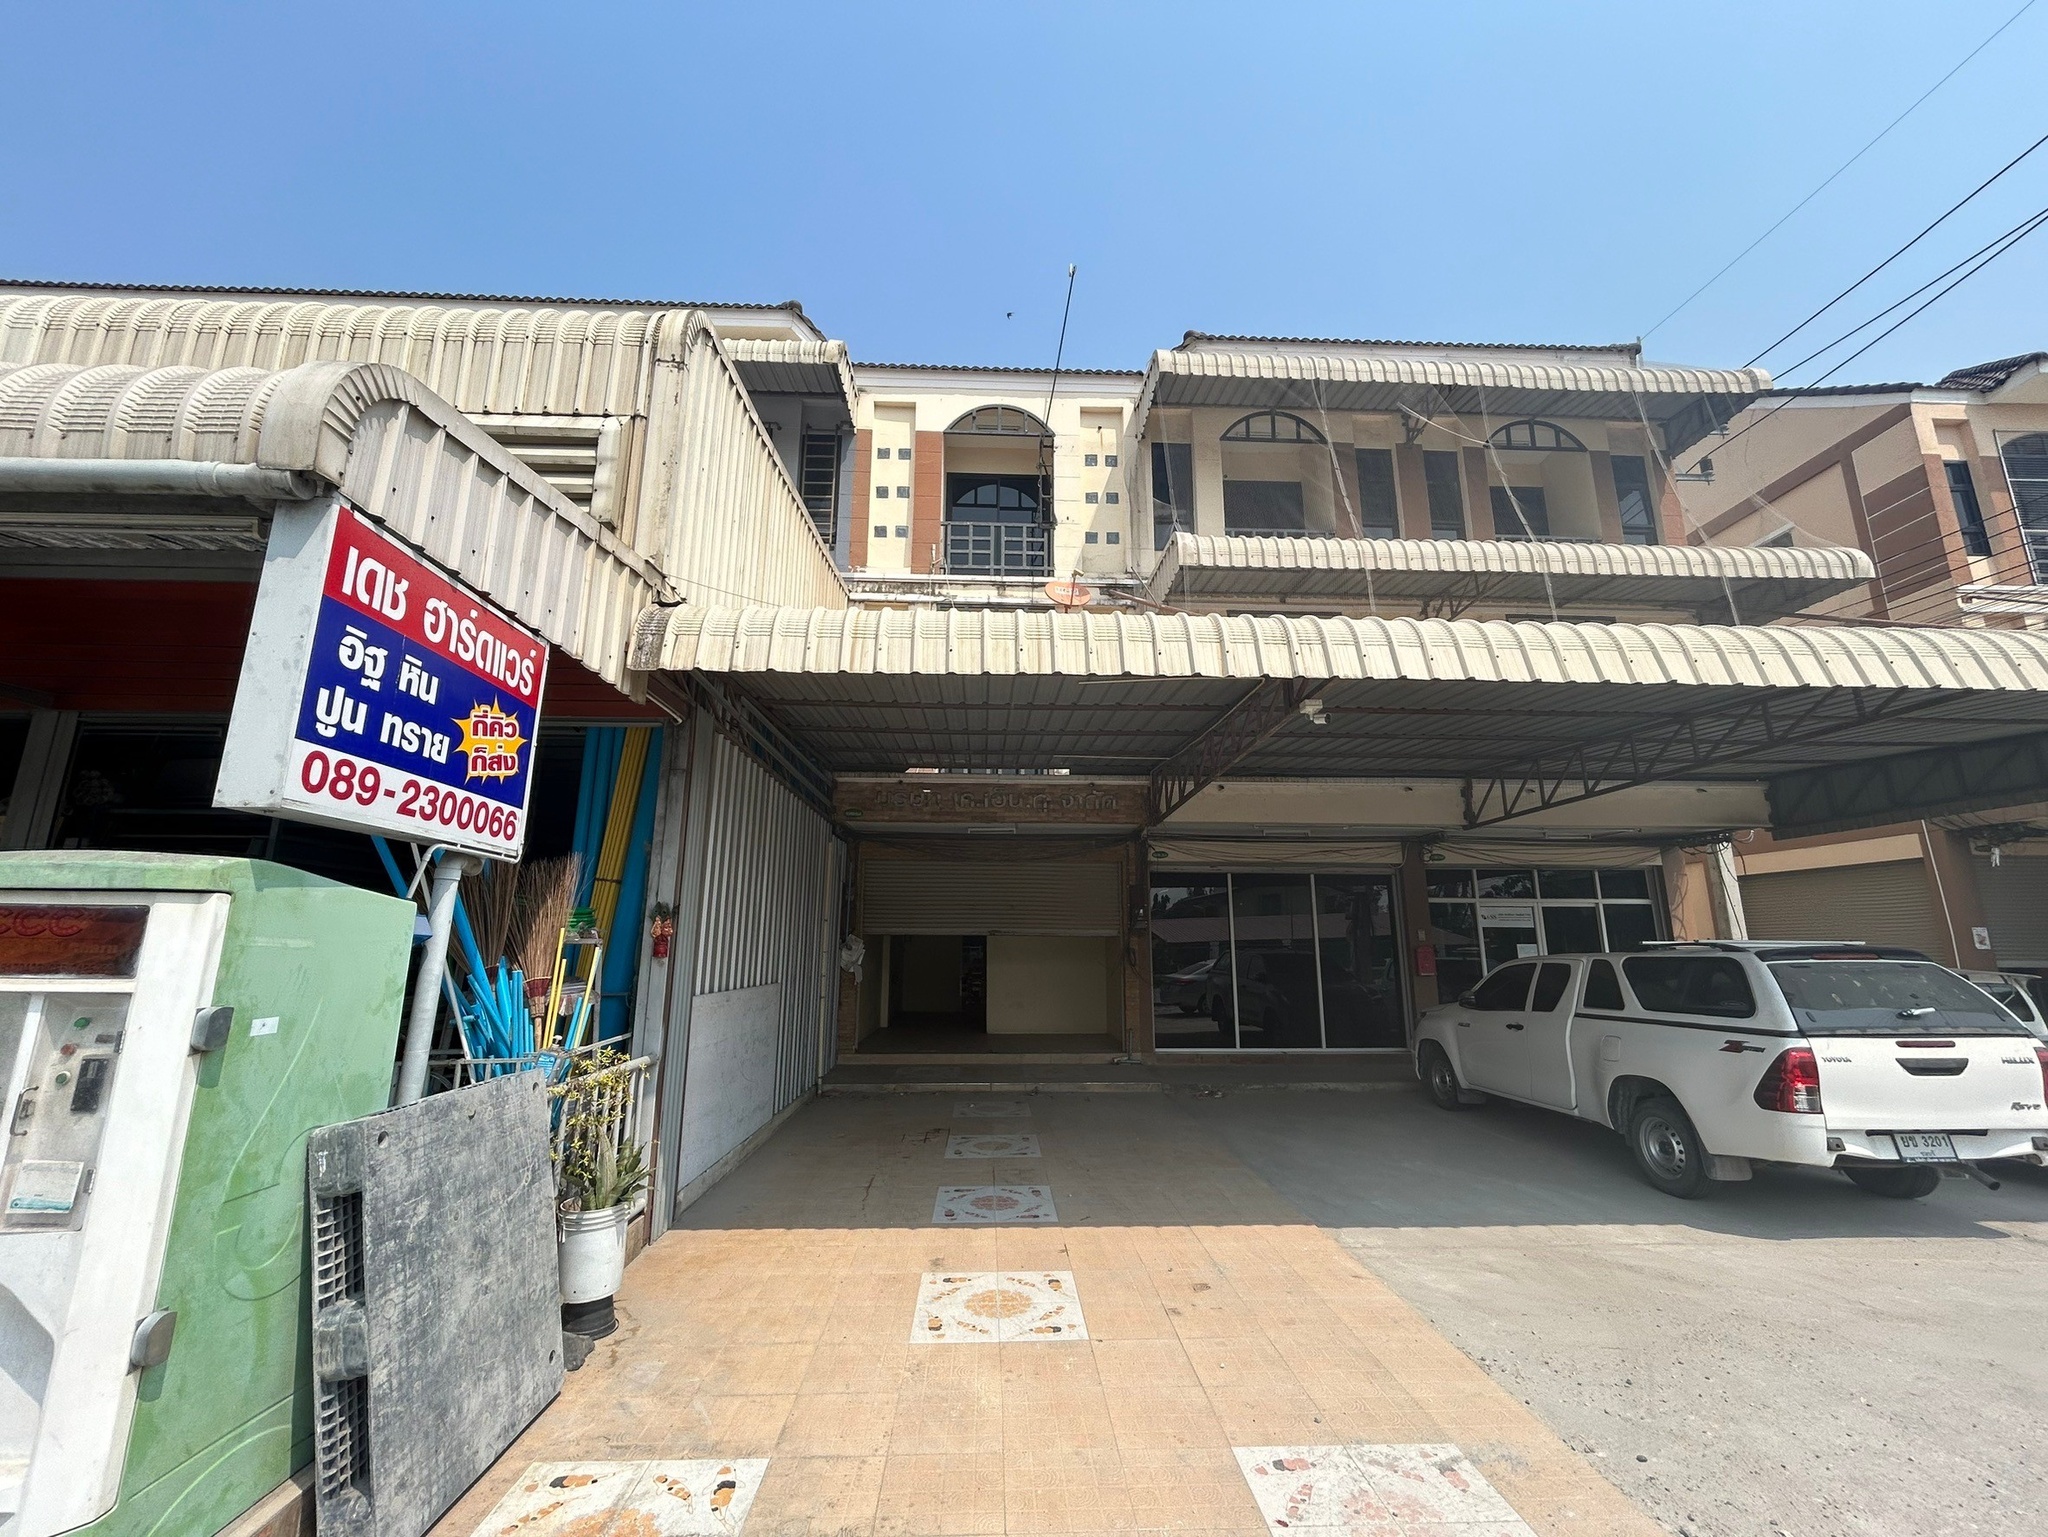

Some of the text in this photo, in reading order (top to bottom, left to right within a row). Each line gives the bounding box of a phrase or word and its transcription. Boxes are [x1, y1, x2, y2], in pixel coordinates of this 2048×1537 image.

[341, 545, 537, 697] เดช ฮาร์ดแวร์
[338, 624, 440, 706] อิฐ หิน
[315, 685, 451, 765] ปูน ทราย
[471, 744, 517, 772] ก็ส่ง
[301, 750, 518, 842] 089-2300066
[1922, 1135, 1949, 1147] 3201
